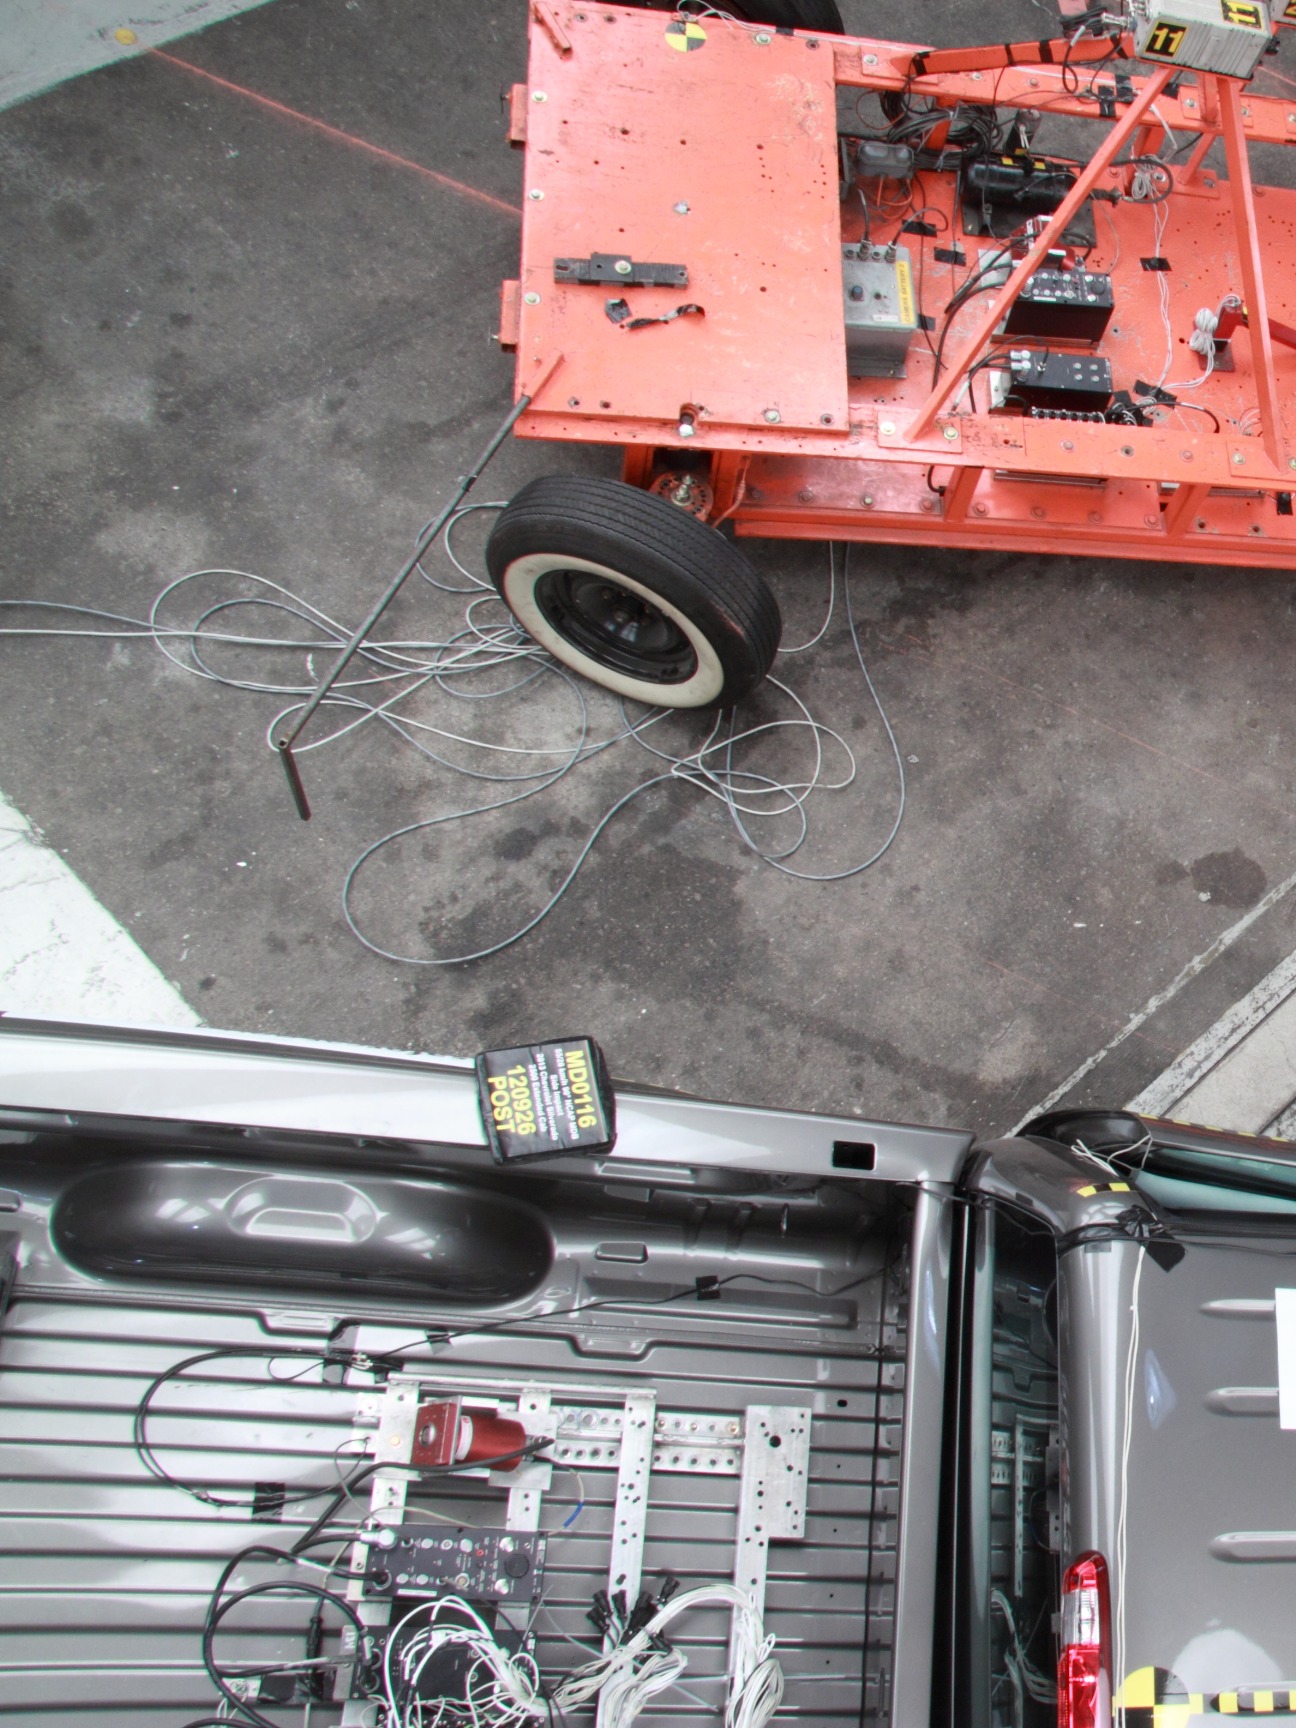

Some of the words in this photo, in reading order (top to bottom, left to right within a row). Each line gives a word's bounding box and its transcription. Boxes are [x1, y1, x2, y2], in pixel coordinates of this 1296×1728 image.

[1227, 1, 1256, 24] 11
[1154, 28, 1184, 53] 11
[550, 1074, 560, 1090] Side
[565, 1050, 598, 1128] MD0116
[488, 1075, 516, 1133] POST
[507, 1064, 536, 1136] 120926
[532, 1081, 545, 1116] Extended
[539, 1071, 552, 1106] Chevrolet
[546, 1106, 559, 1141] Silverado
[552, 1091, 564, 1116] Impact
[564, 1099, 576, 1121] NCAP
[538, 1117, 548, 1132] Cab
[569, 1121, 580, 1140] MDB
